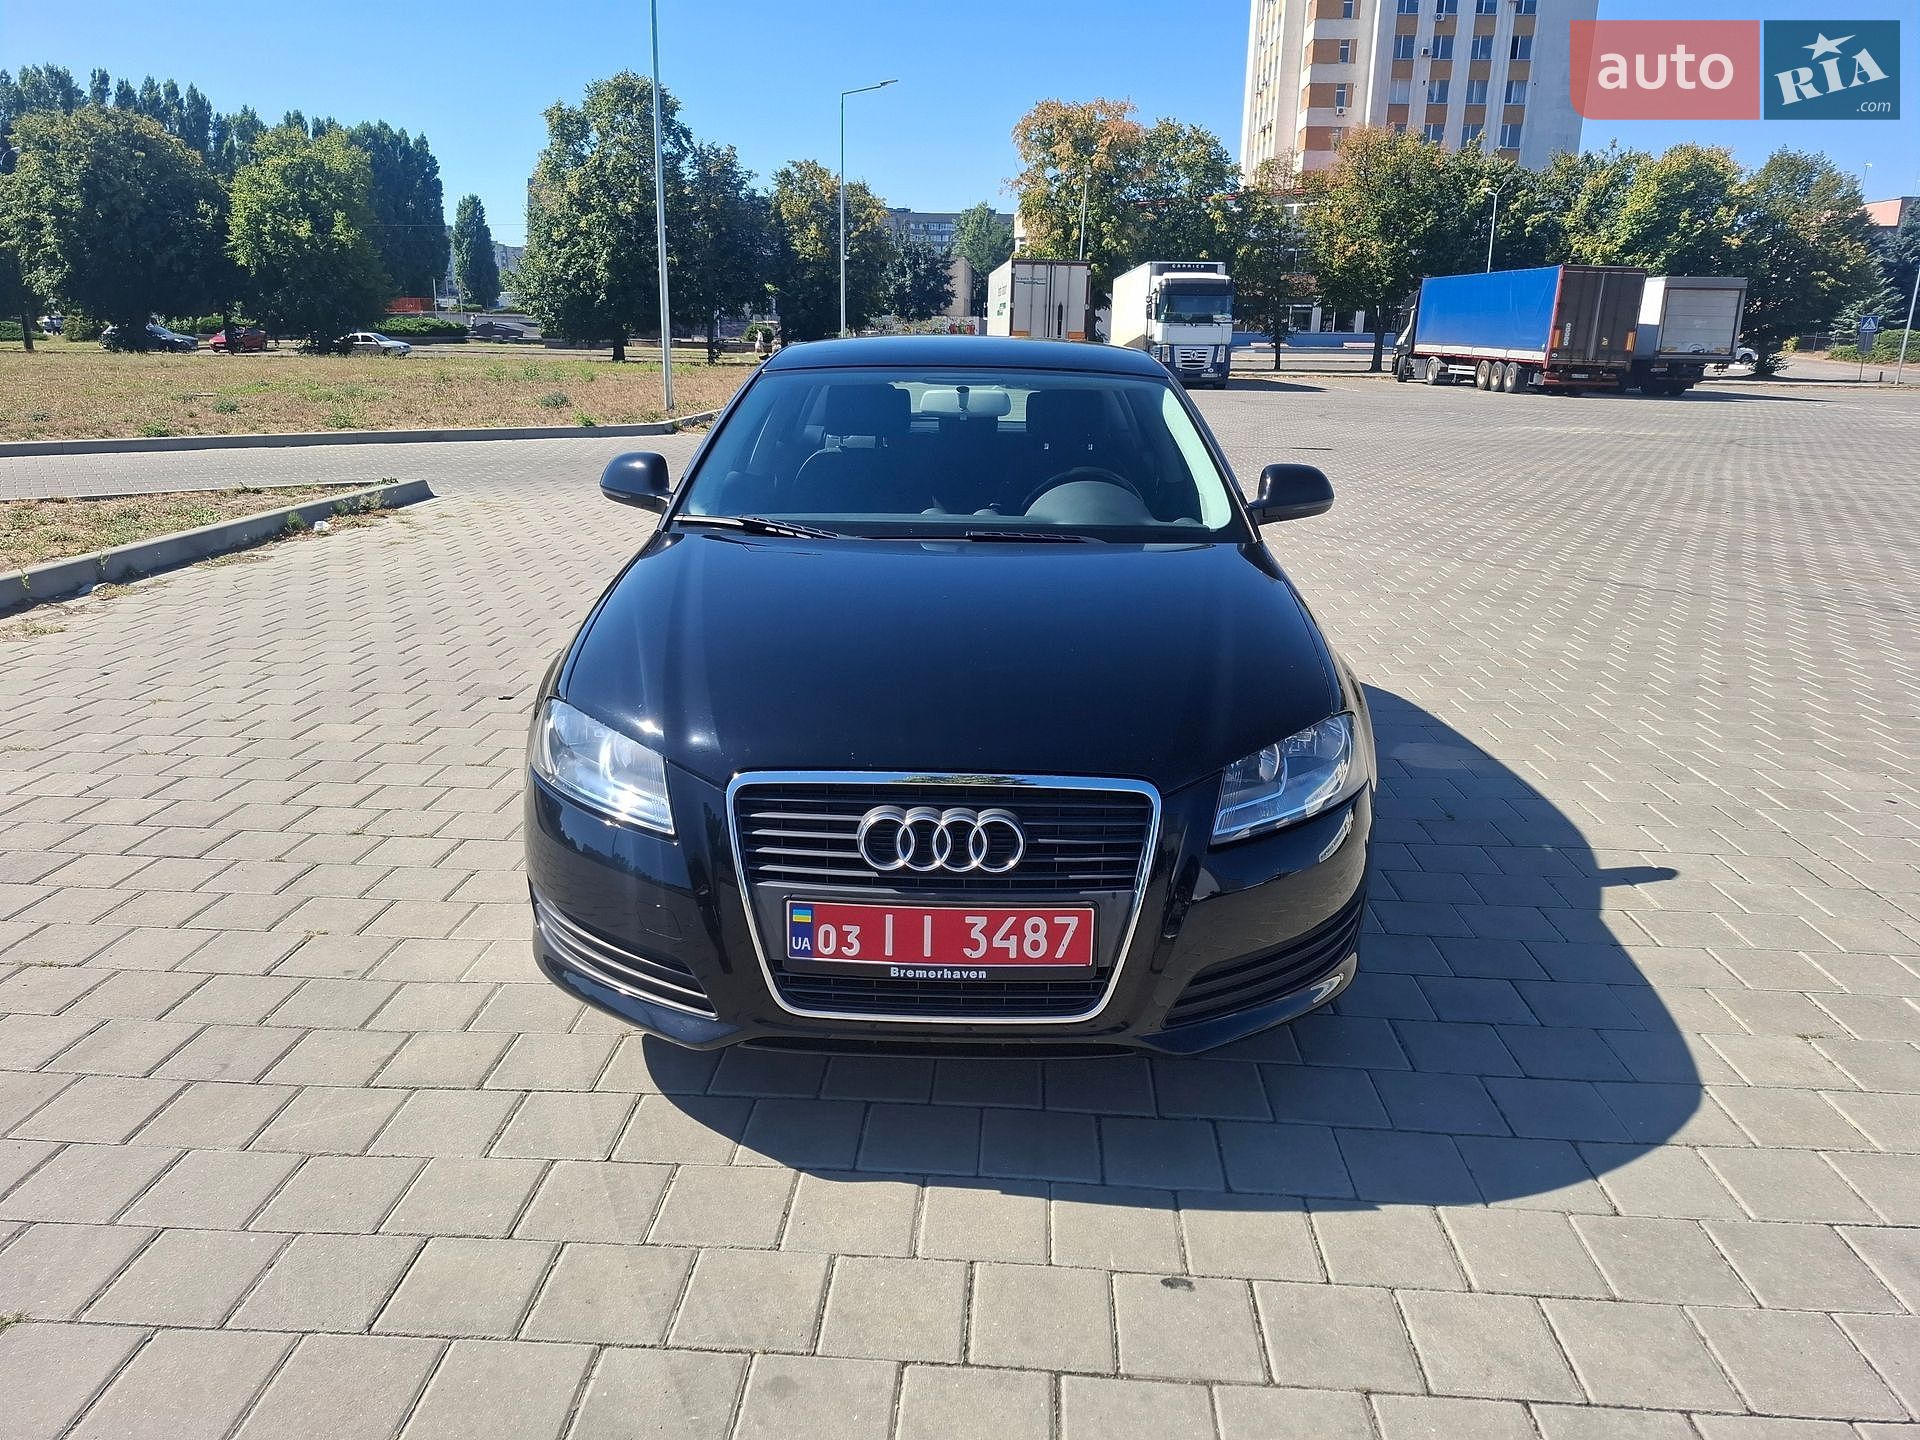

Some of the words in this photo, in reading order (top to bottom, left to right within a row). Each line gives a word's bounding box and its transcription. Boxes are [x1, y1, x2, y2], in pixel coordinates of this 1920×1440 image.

[792, 936, 811, 951] UA
[817, 923, 861, 957] 03
[963, 916, 1079, 959] 3487
[890, 966, 987, 979] Bremerhaven
